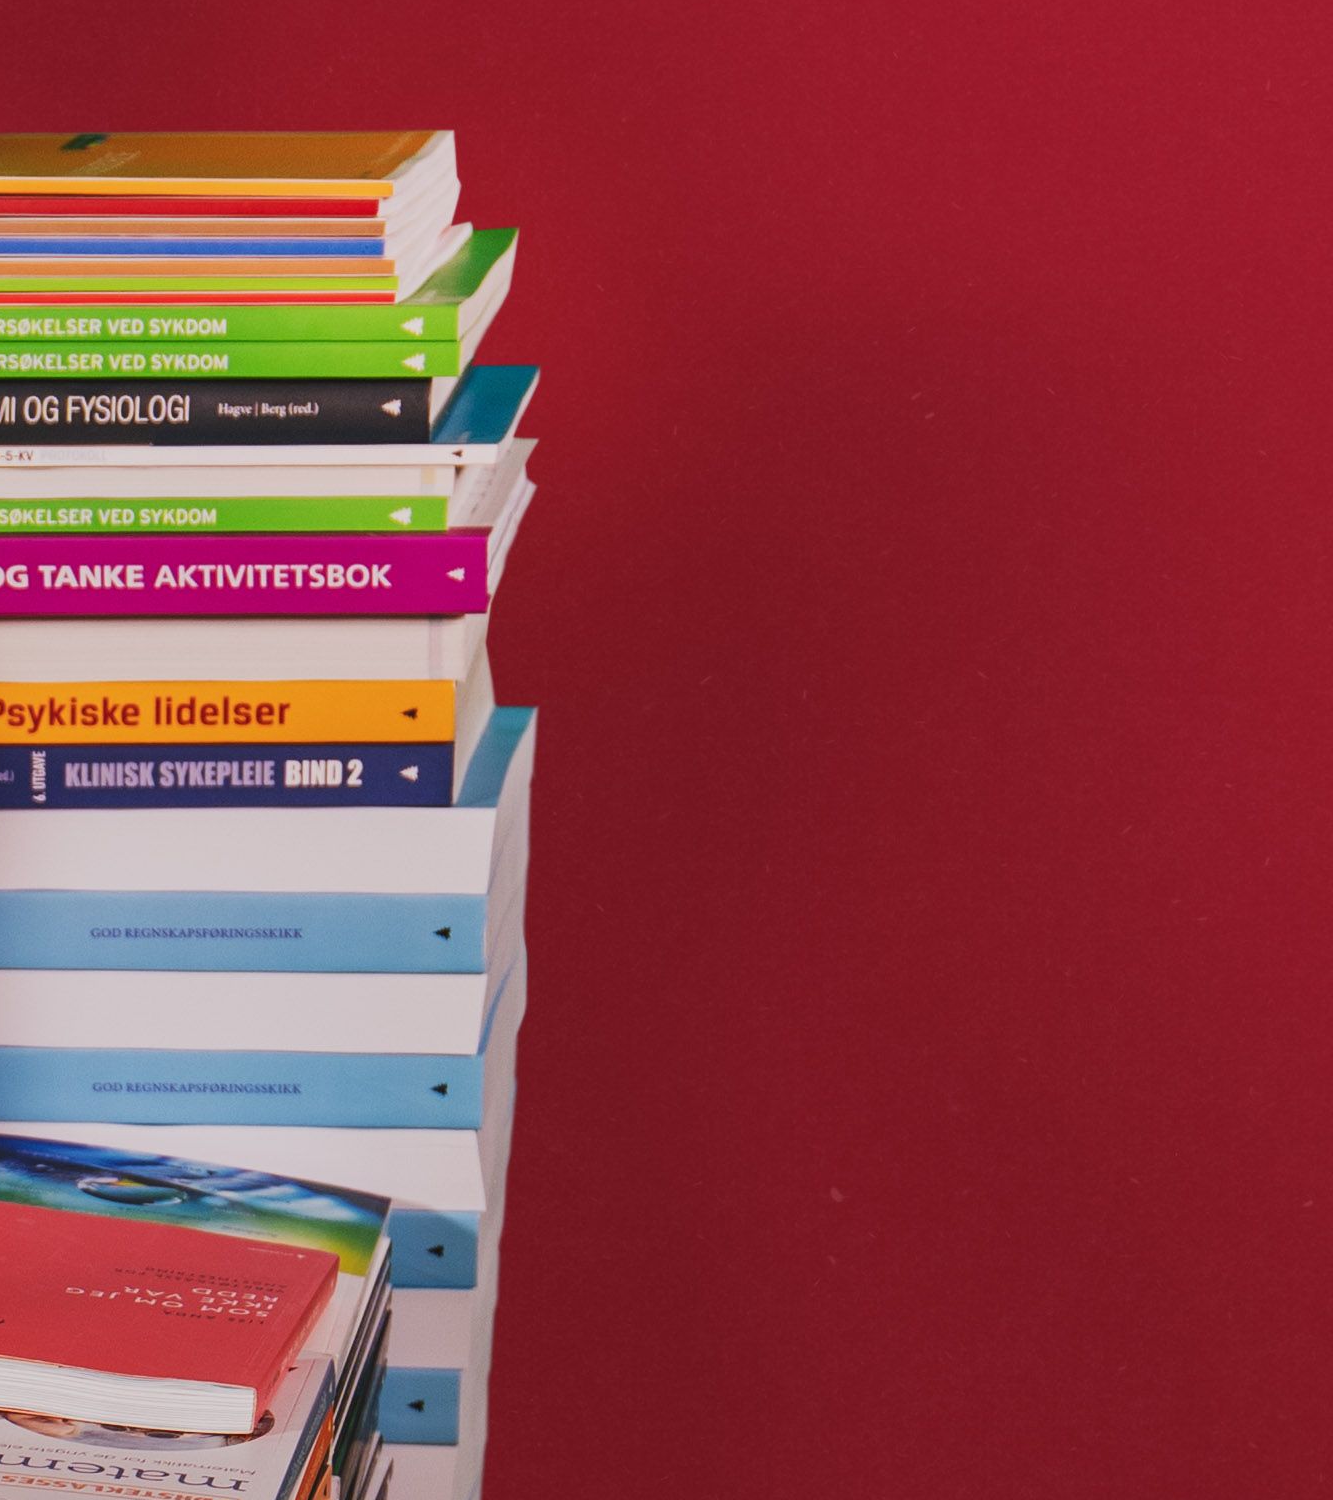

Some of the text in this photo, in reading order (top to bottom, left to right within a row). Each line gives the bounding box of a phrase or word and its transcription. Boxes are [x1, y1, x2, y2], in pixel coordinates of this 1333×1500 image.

[107, 318, 144, 335] VED
[149, 318, 228, 335] SYKDOM
[24, 396, 59, 425] OG
[66, 395, 190, 425] FYSIOLOGI
[217, 402, 287, 419] Hagve Berg
[38, 564, 144, 589] TANKE
[153, 563, 393, 589] AKTIVITETSBOK
[154, 696, 290, 727] lidelser
[32, 750, 47, 789] UTGAVE
[65, 759, 363, 788] KLINISK SYKEPLEIE BIND 2
[89, 927, 303, 940] GOD REGNSKAPSFØRINGSSKIKK
[92, 1082, 302, 1095] GOD REGNSKAPSFØRINGSSKIKK
[65, 1285, 271, 1318] SOM OM JEG
[124, 1285, 275, 1311] IKKE VAR
[191, 1286, 280, 1306] REDD
[30, 1444, 90, 1461] yngste
[148, 1458, 258, 1477] Matematikk
